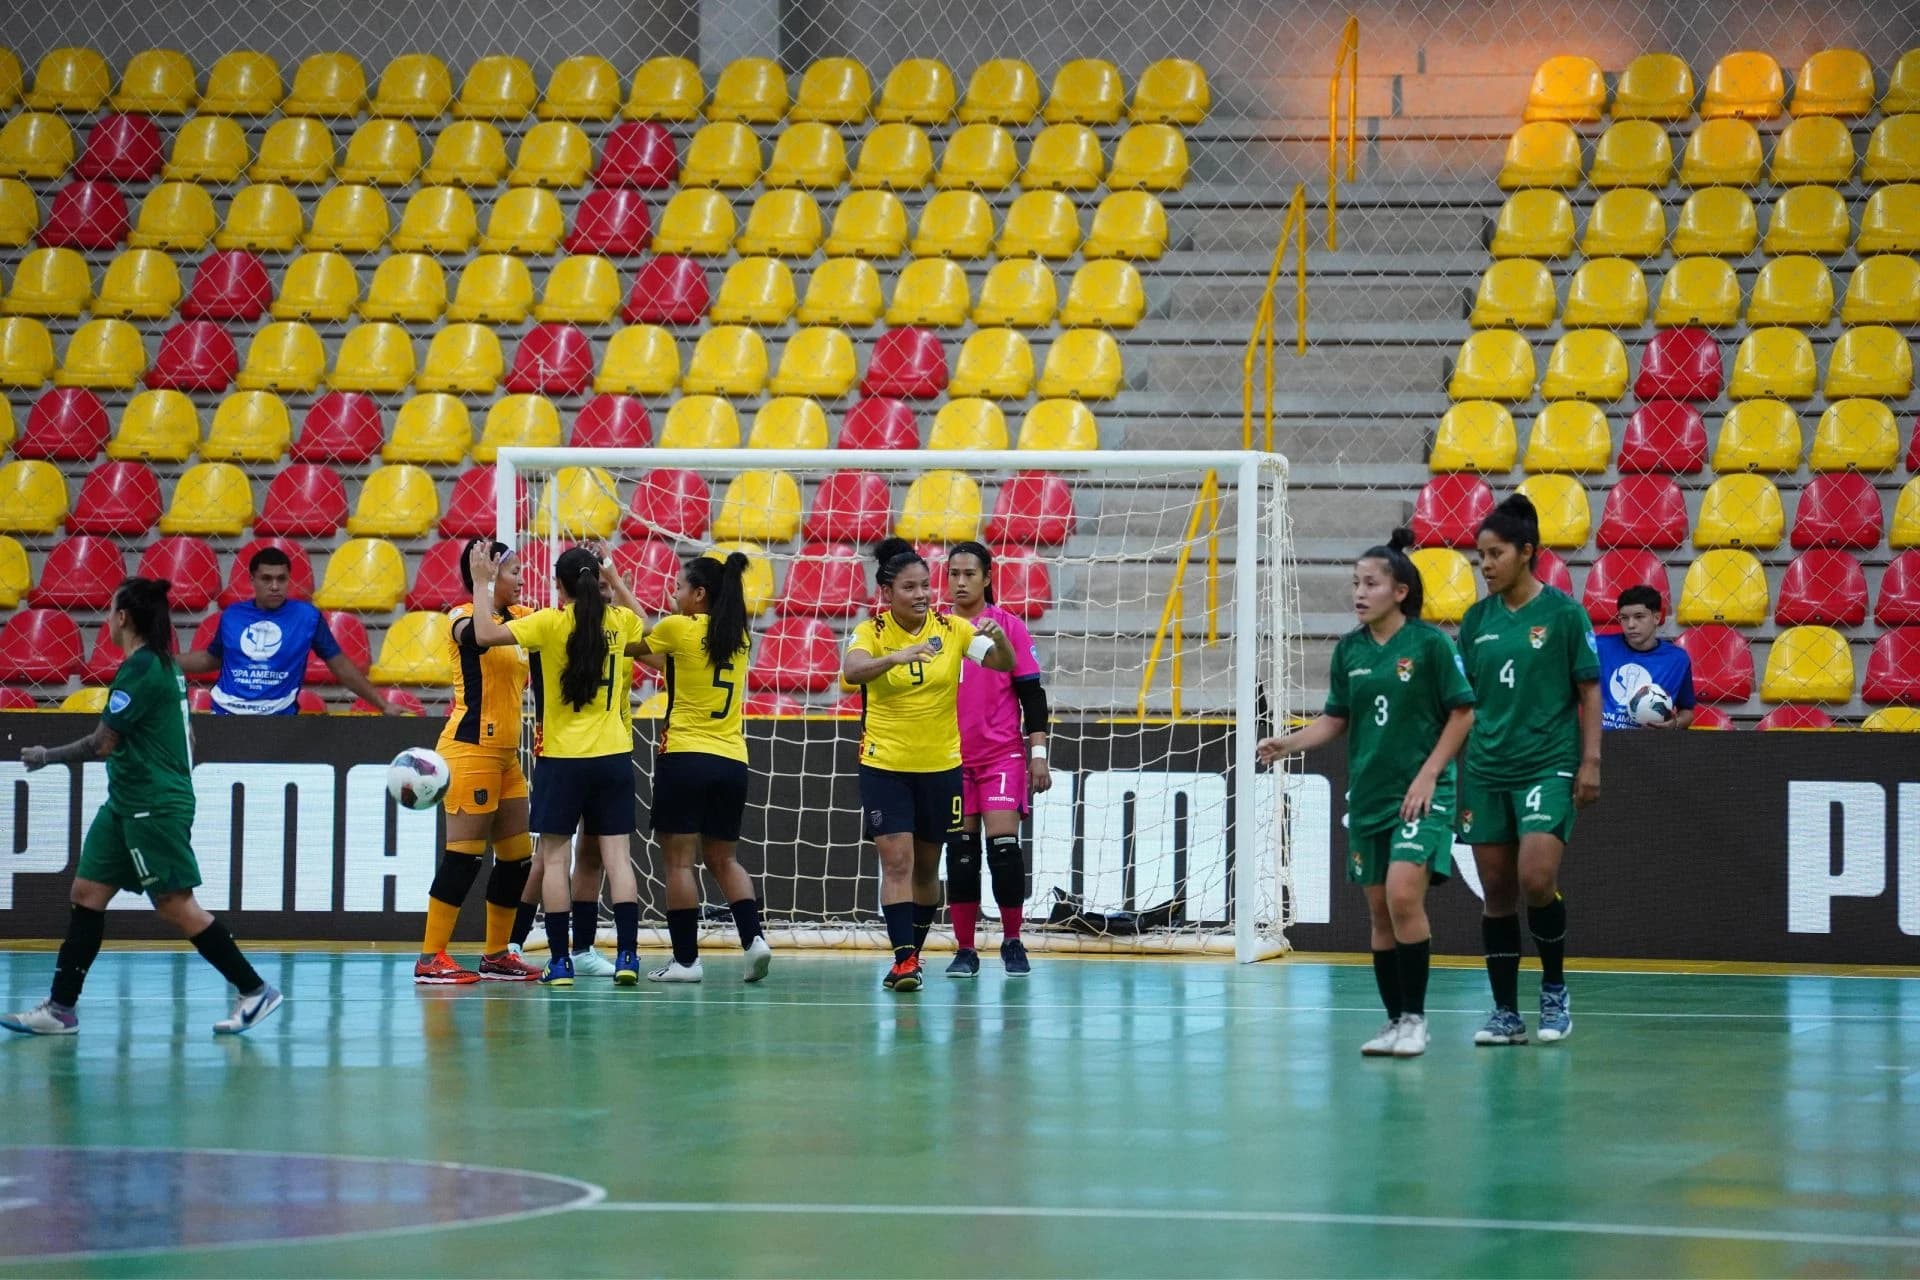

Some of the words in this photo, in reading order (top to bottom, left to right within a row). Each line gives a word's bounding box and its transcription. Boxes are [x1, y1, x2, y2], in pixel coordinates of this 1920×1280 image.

[573, 654, 616, 713] 4
[909, 660, 924, 686] 9
[1499, 658, 1515, 688] 4
[710, 662, 735, 719] 5
[1374, 694, 1389, 727] 3
[998, 772, 1007, 794] 1
[1526, 785, 1543, 812] 4
[951, 795, 963, 824] 9
[0, 760, 437, 912] PMA
[1401, 818, 1420, 839] 3
[130, 847, 149, 878] 11
[878, 771, 1331, 924] UMA
[1787, 780, 1920, 936] P
